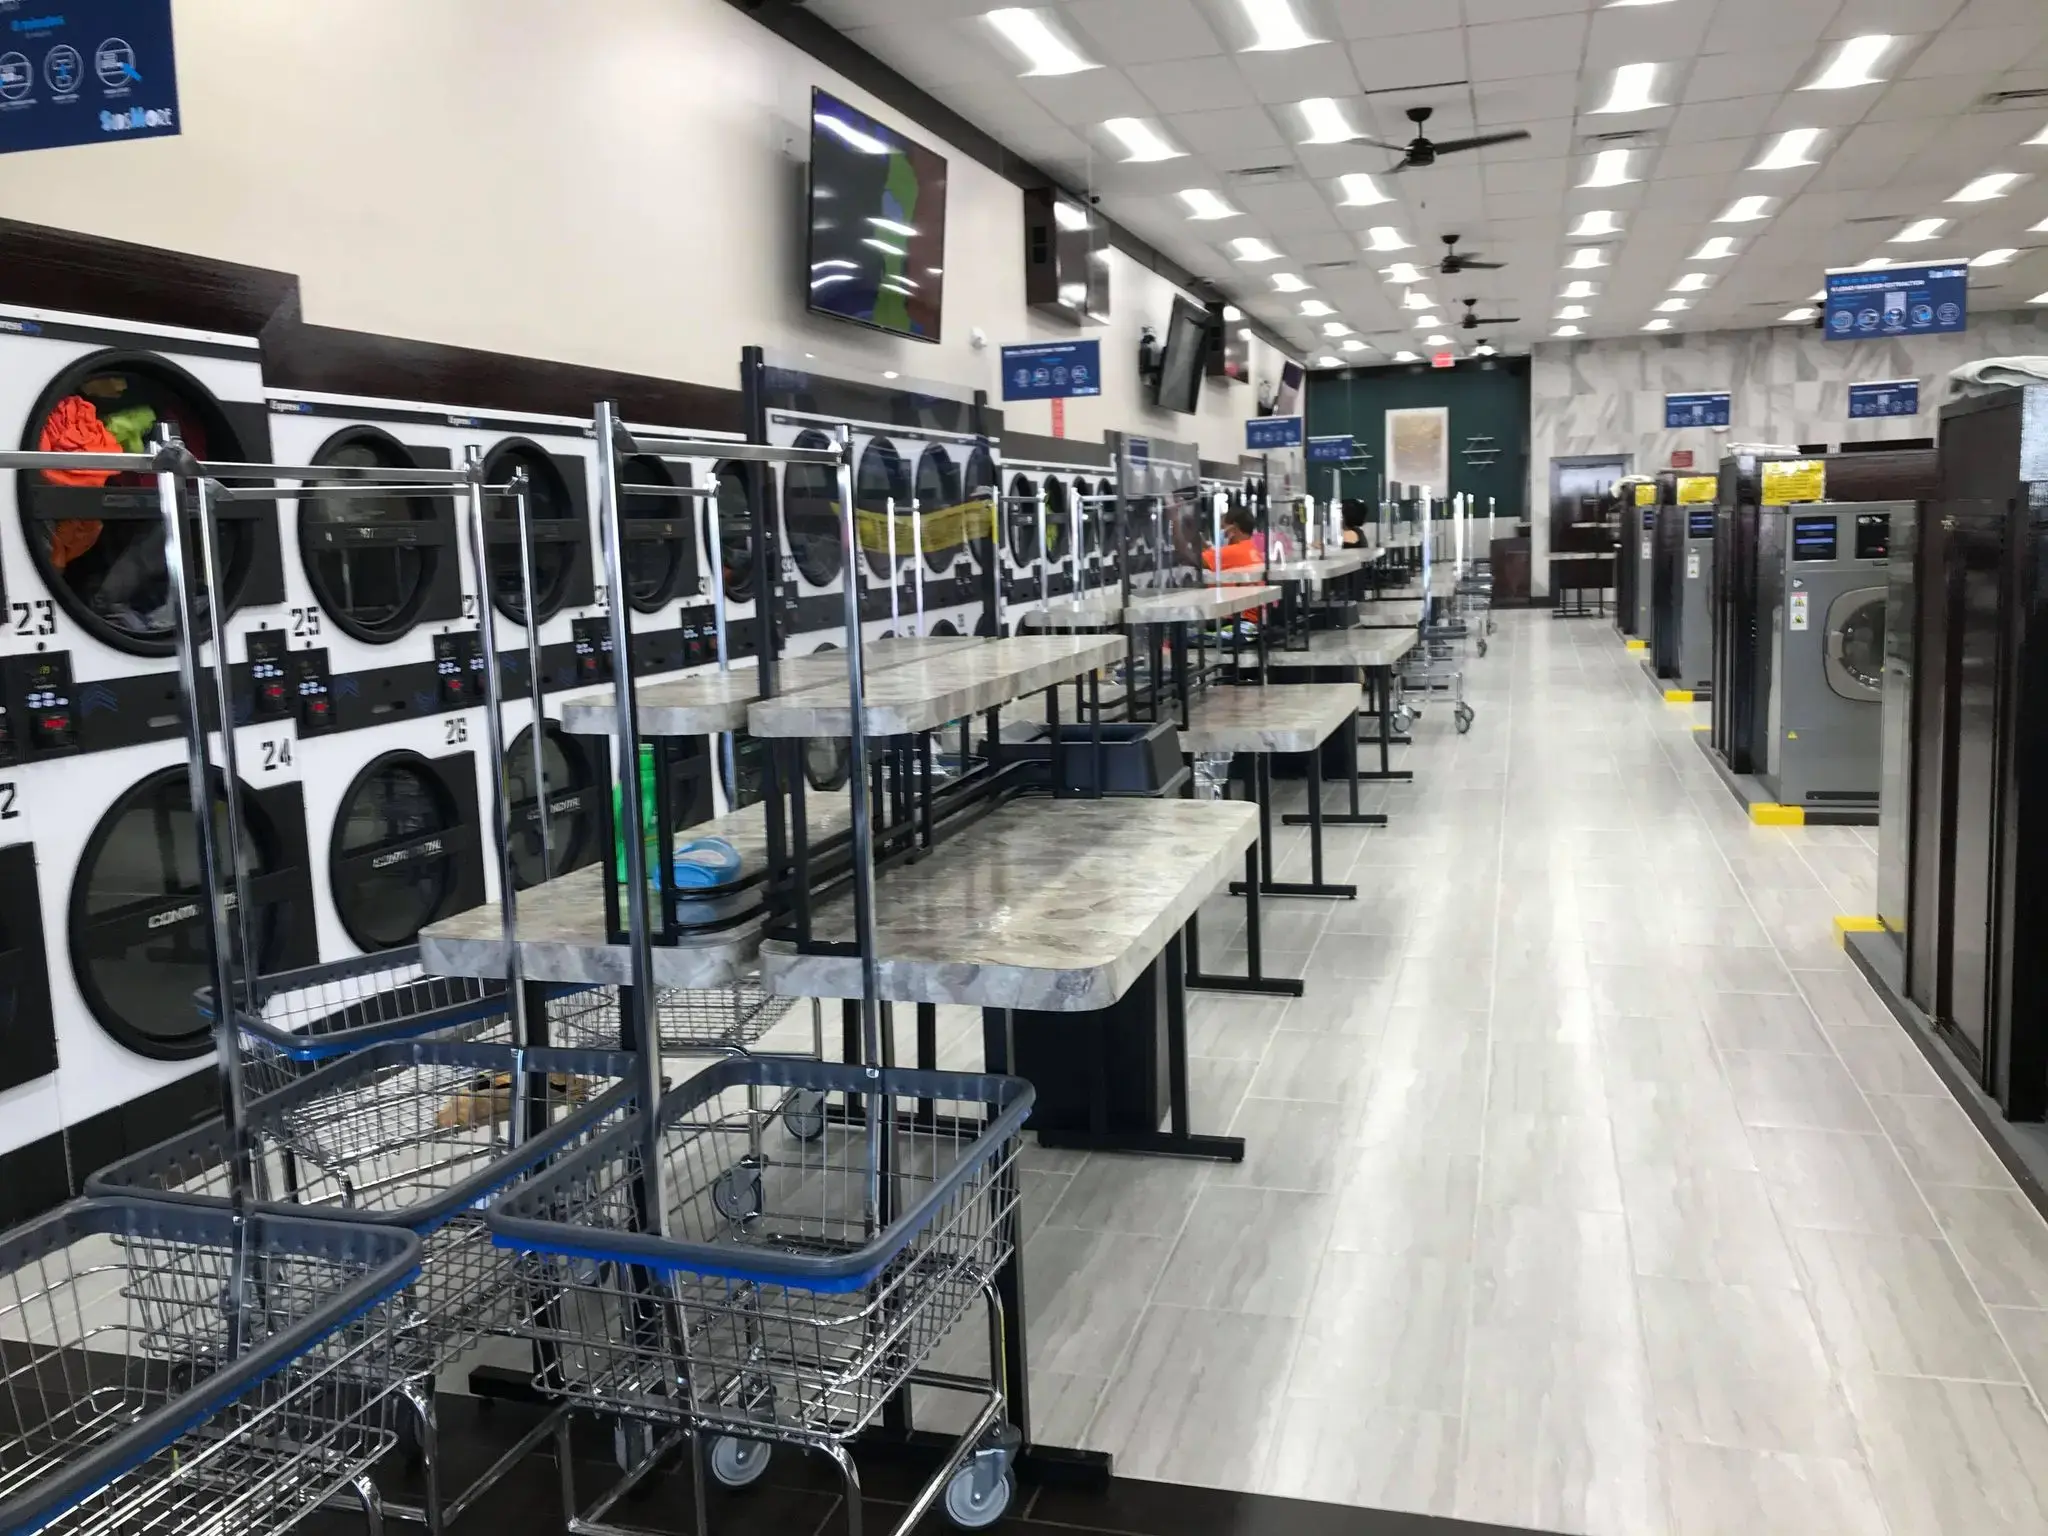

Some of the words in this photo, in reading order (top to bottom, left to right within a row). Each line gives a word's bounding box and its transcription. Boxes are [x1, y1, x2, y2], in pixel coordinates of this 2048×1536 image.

[12, 600, 57, 636] 23
[290, 606, 320, 637] 25
[261, 738, 292, 771] 24
